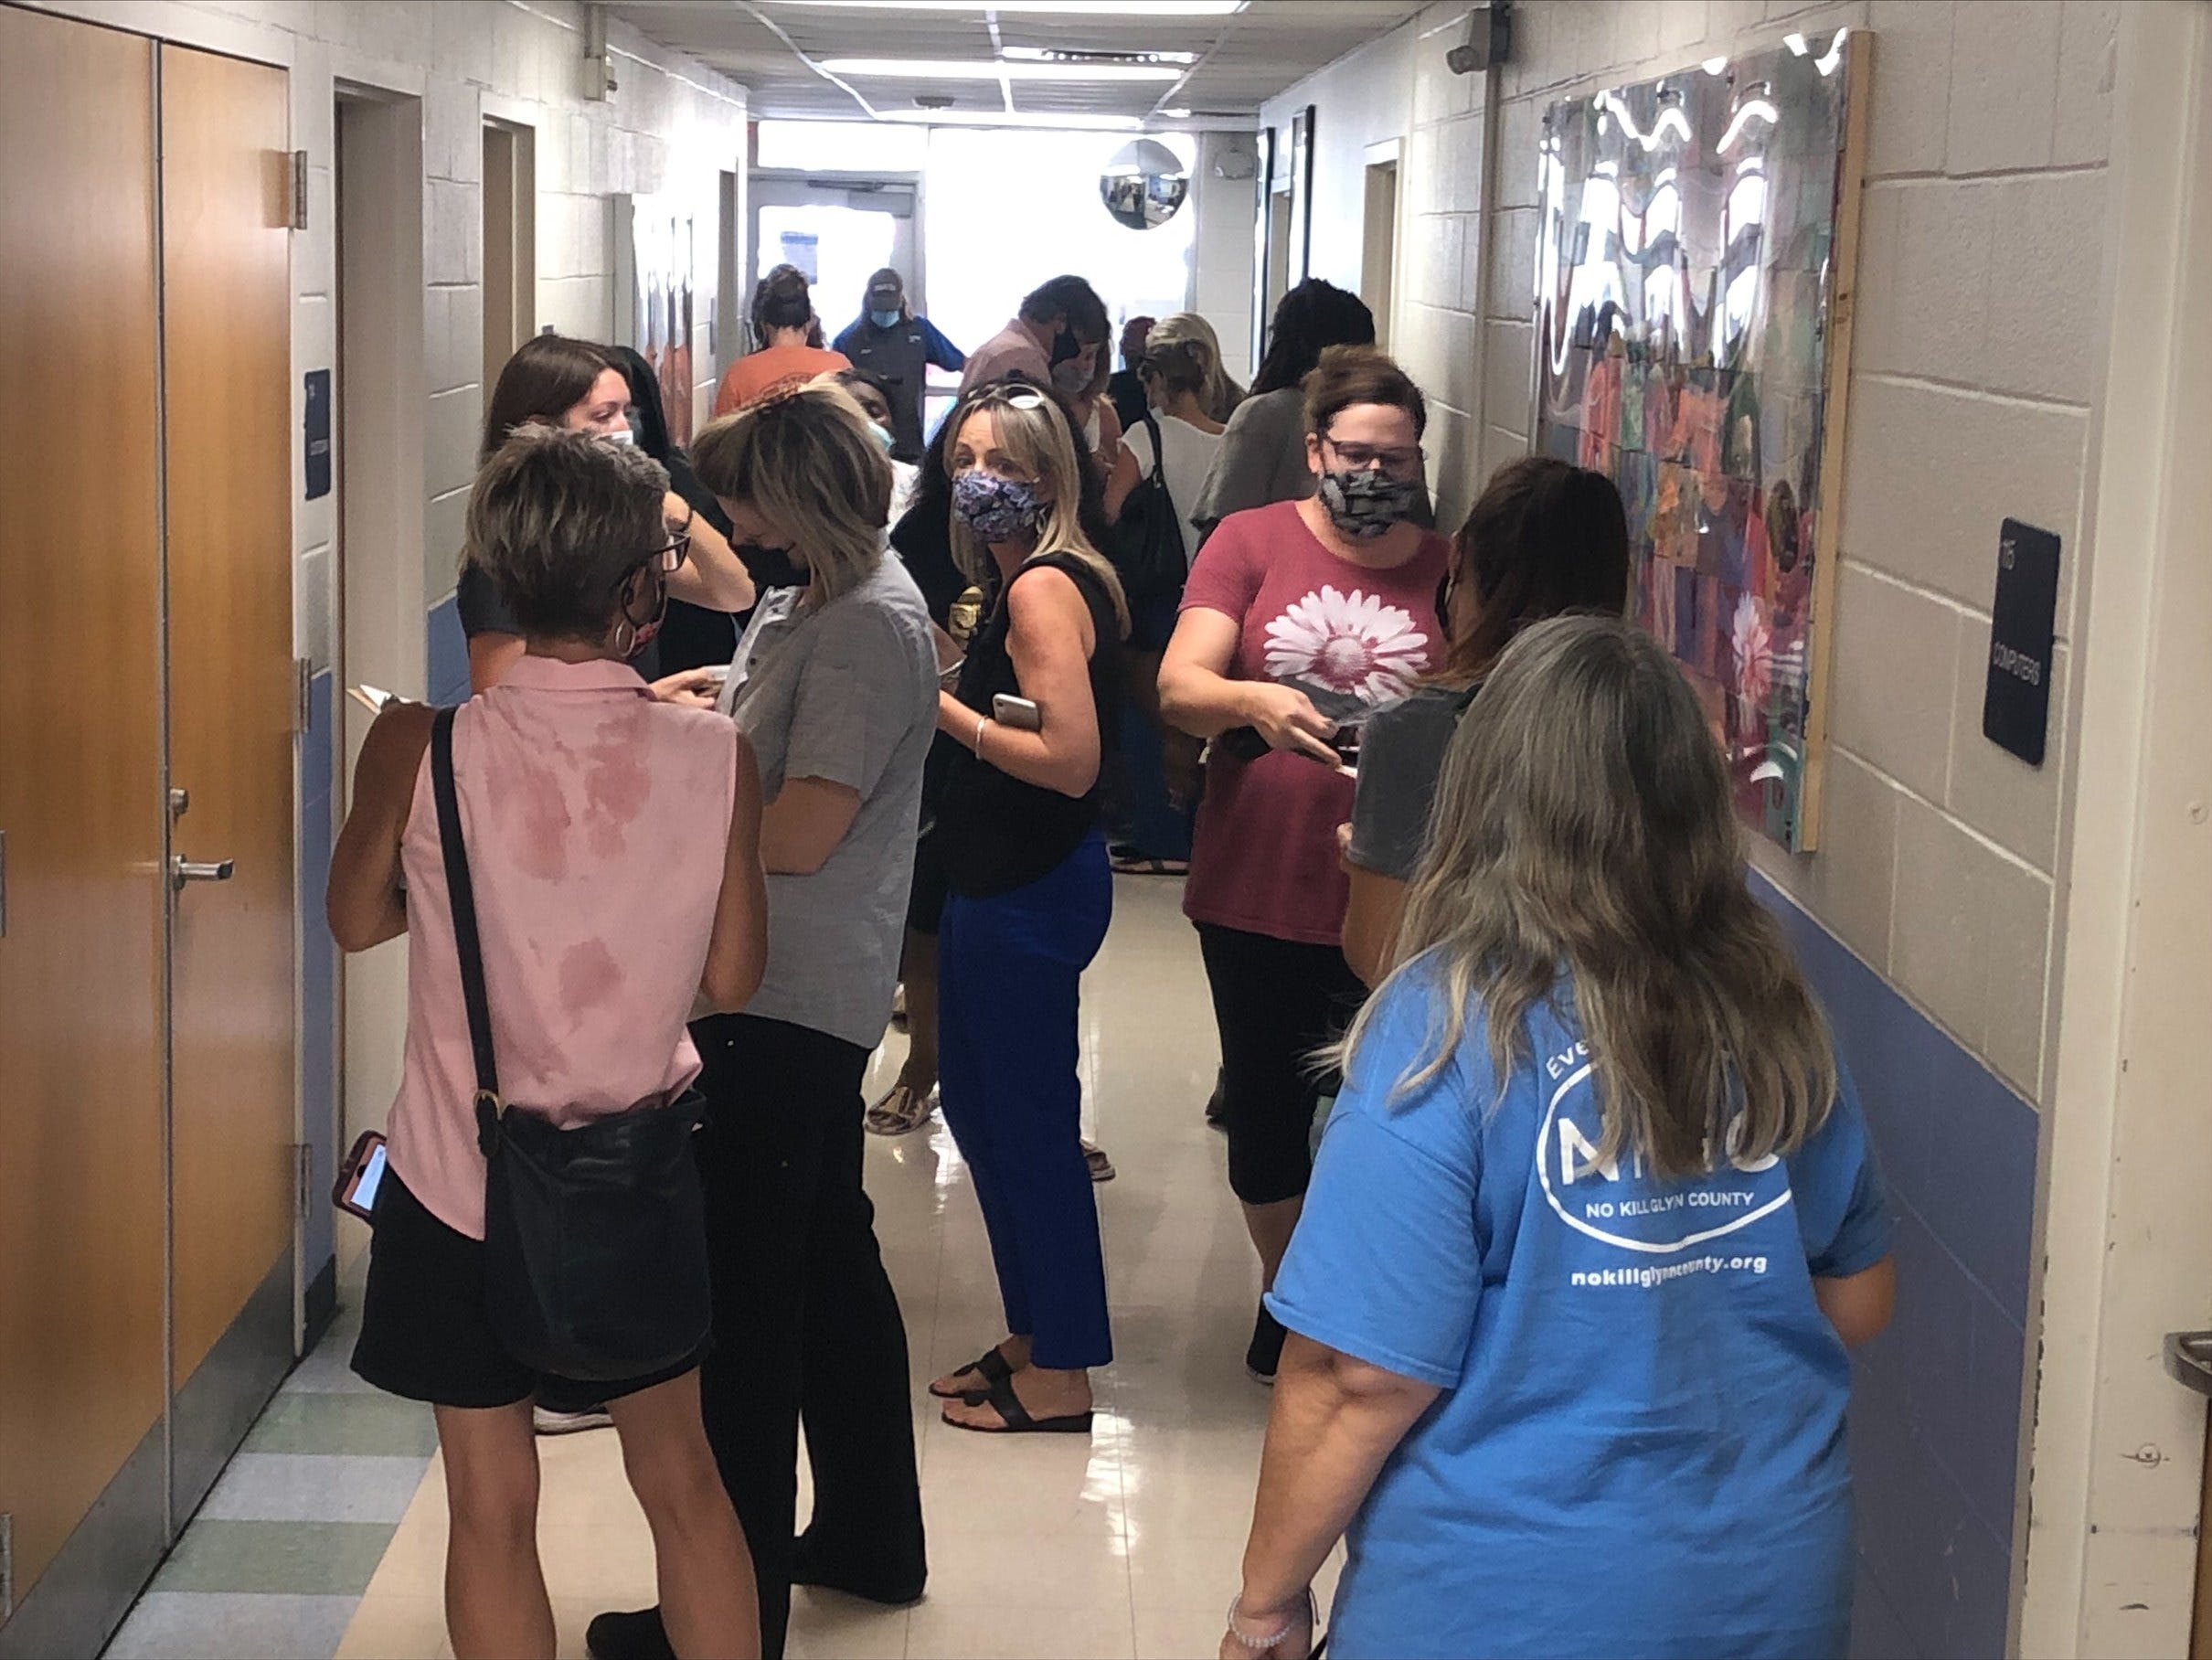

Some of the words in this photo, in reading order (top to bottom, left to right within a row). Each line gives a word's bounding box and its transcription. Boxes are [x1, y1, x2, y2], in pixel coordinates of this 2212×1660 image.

[1545, 1038, 1590, 1080] Eve
[1586, 1203, 1614, 1218] NO
[1620, 1199, 1650, 1217] KILL
[1687, 1191, 1755, 1208] COUNTY
